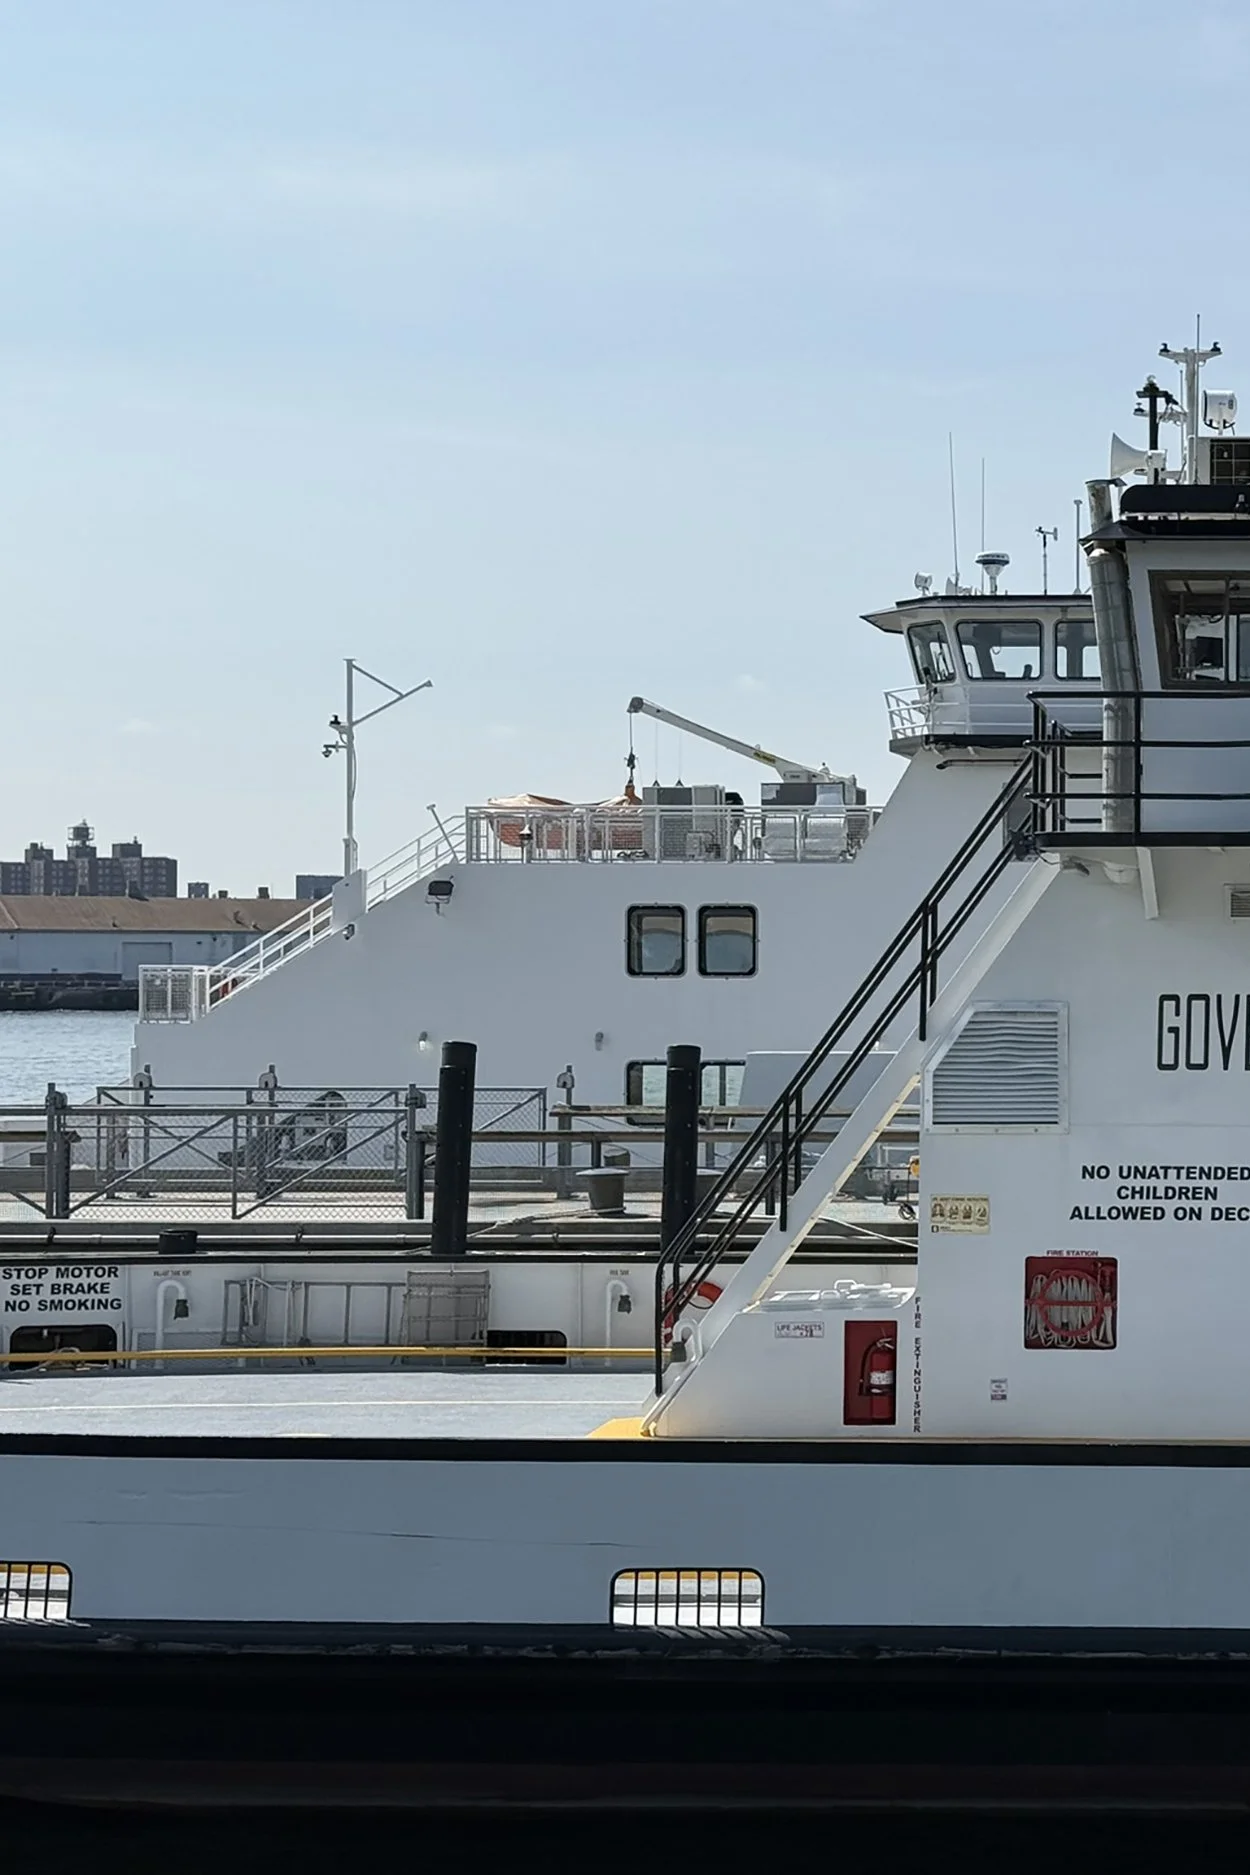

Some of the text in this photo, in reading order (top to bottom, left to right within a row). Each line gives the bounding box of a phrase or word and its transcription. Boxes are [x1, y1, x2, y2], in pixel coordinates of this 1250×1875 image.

[1081, 1165, 1111, 1180] NO
[1116, 1186, 1218, 1201] CHILDREN
[1069, 1206, 1166, 1221] ALLOWED
[1173, 1207, 1202, 1221] ON
[2, 1266, 119, 1280] STOP MOTOR
[10, 1282, 110, 1296] SET BRAKE
[4, 1298, 122, 1312] NO SMOKING
[913, 1296, 922, 1433] FIRE EXTINGUISHER
